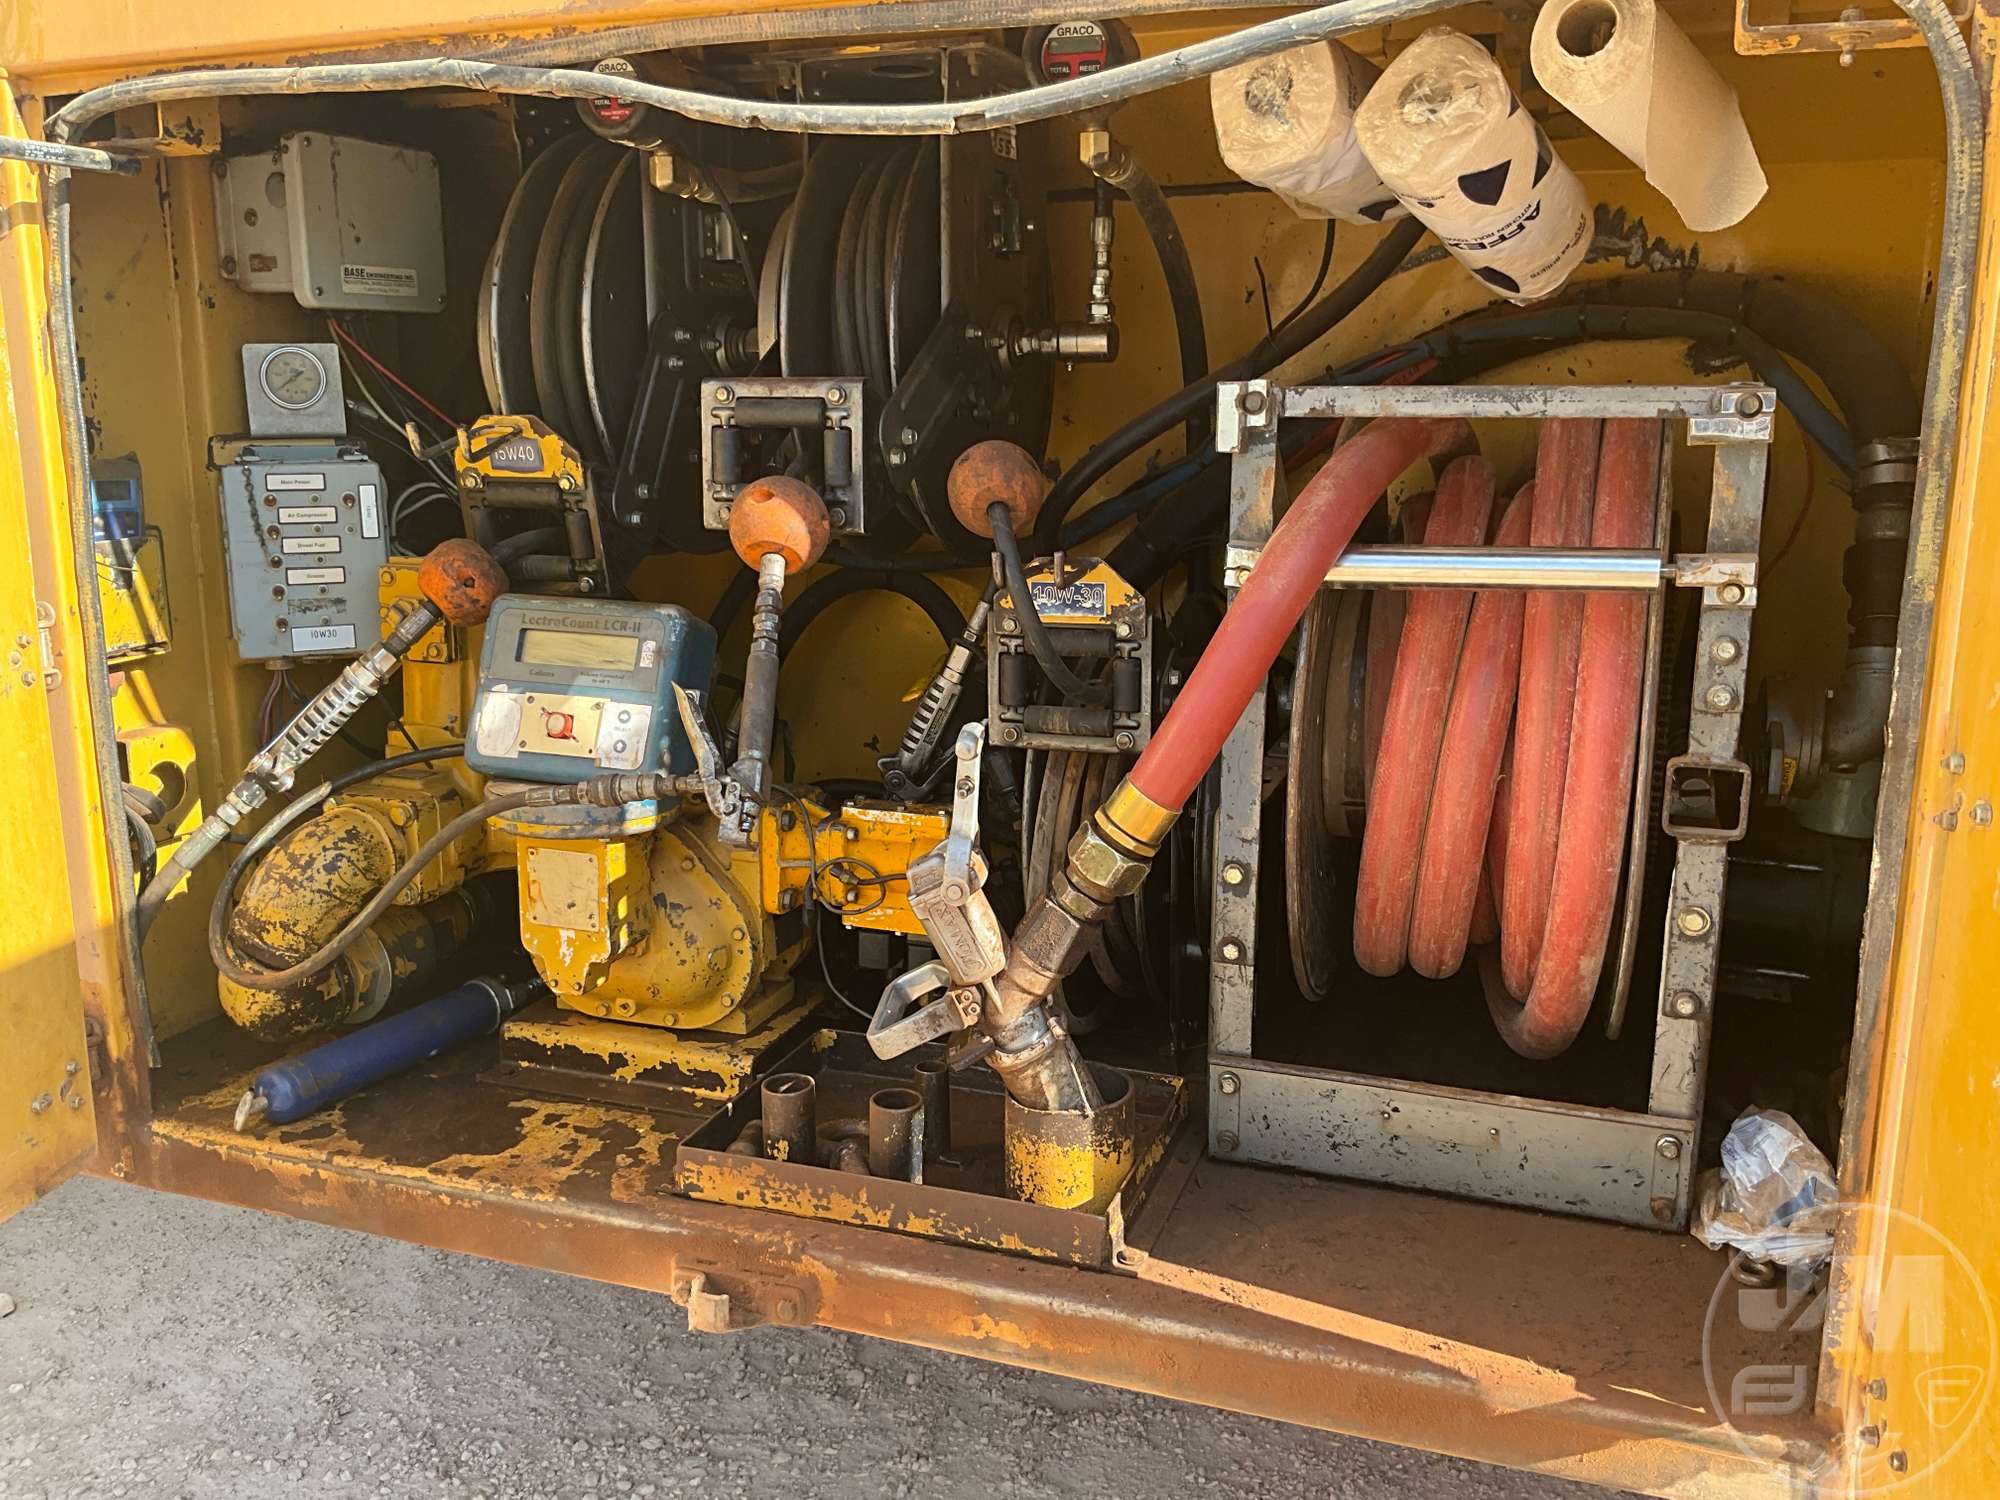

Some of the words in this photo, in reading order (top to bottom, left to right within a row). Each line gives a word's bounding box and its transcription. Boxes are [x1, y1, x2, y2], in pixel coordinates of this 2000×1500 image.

[1057, 25, 1094, 37] GRACO
[598, 62, 628, 73] GRACO
[1049, 66, 1070, 74] TOTAL
[1079, 64, 1101, 73] RESET
[1496, 203, 1533, 234] KITCHEN
[1474, 231, 1496, 243] ROLL
[344, 267, 366, 278] BASE
[494, 445, 535, 461] 15W40
[1033, 585, 1104, 605] 10W-30
[520, 613, 600, 630] LectroCount
[310, 629, 338, 639] 10W30
